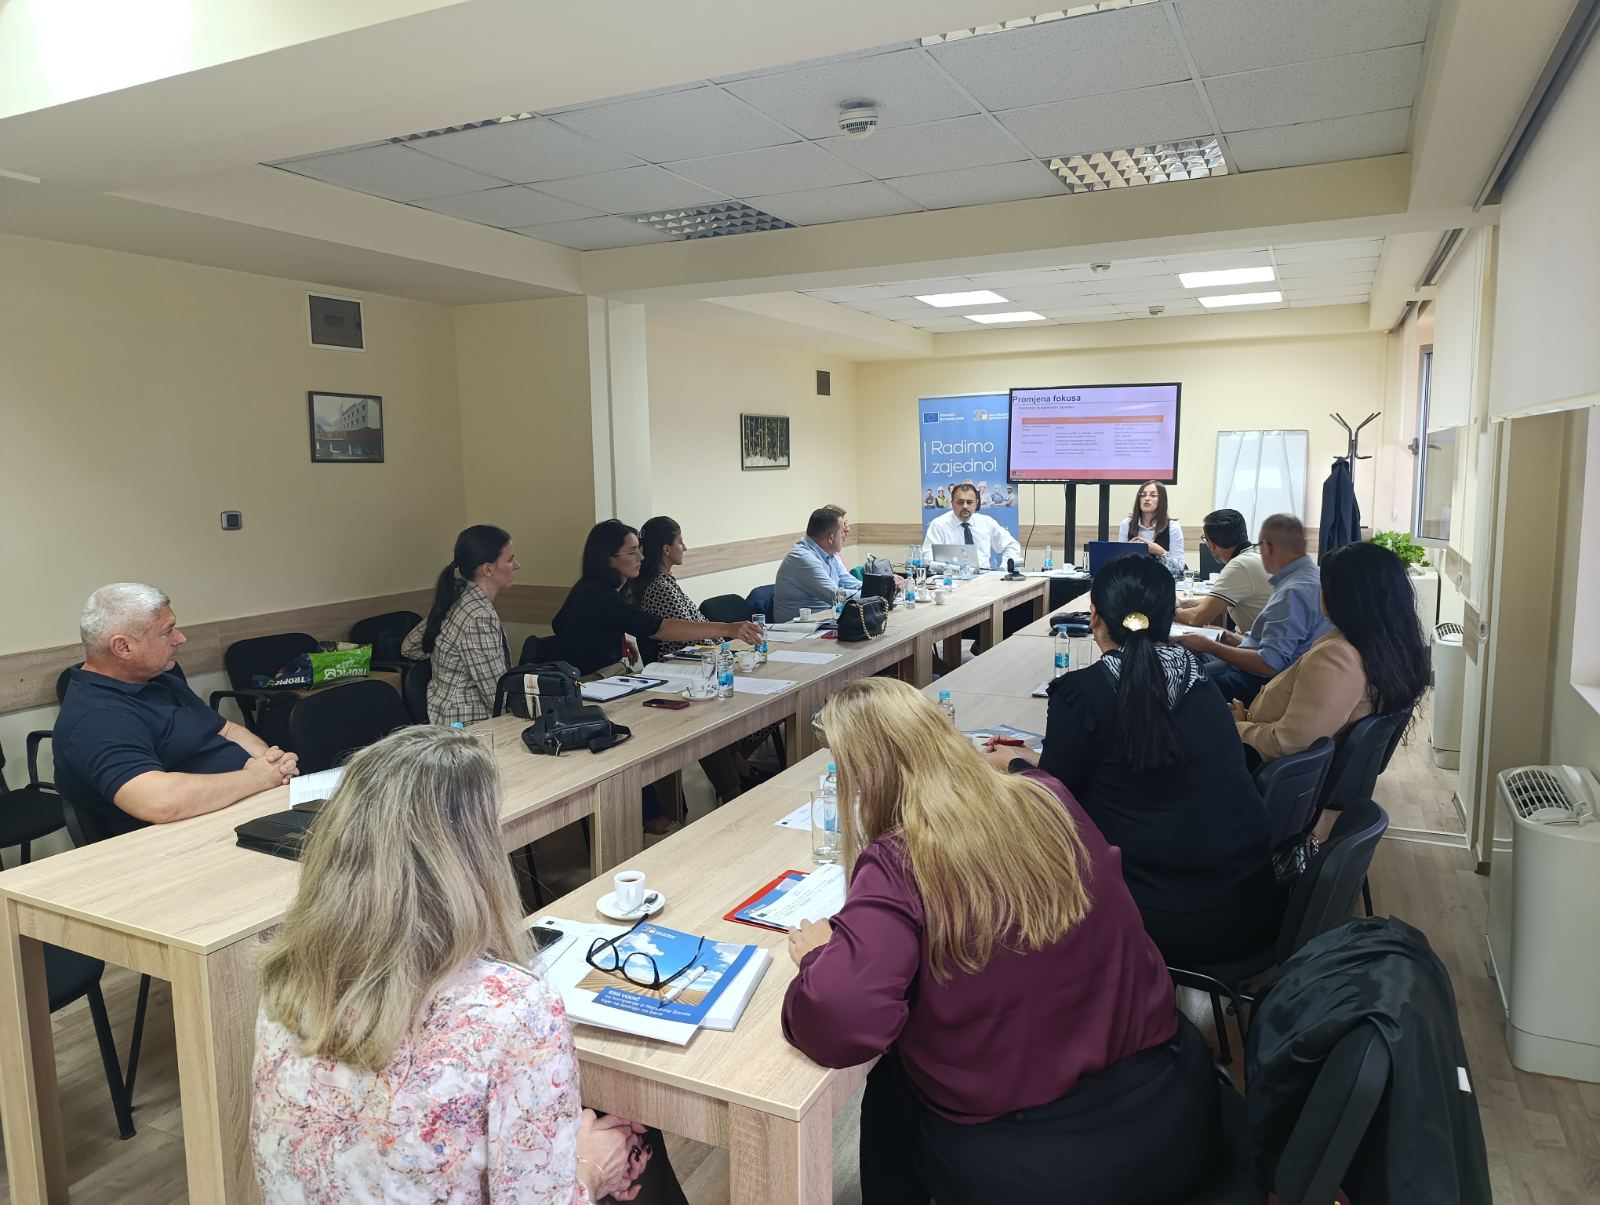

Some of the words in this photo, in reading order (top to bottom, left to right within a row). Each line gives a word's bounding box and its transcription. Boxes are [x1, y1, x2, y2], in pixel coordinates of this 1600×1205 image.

[1012, 395, 1051, 404] Promjena
[931, 440, 994, 455] Radimo
[932, 457, 997, 478] zajedno!
[336, 668, 367, 678] TROPIC
[274, 676, 305, 686] TROPIC
